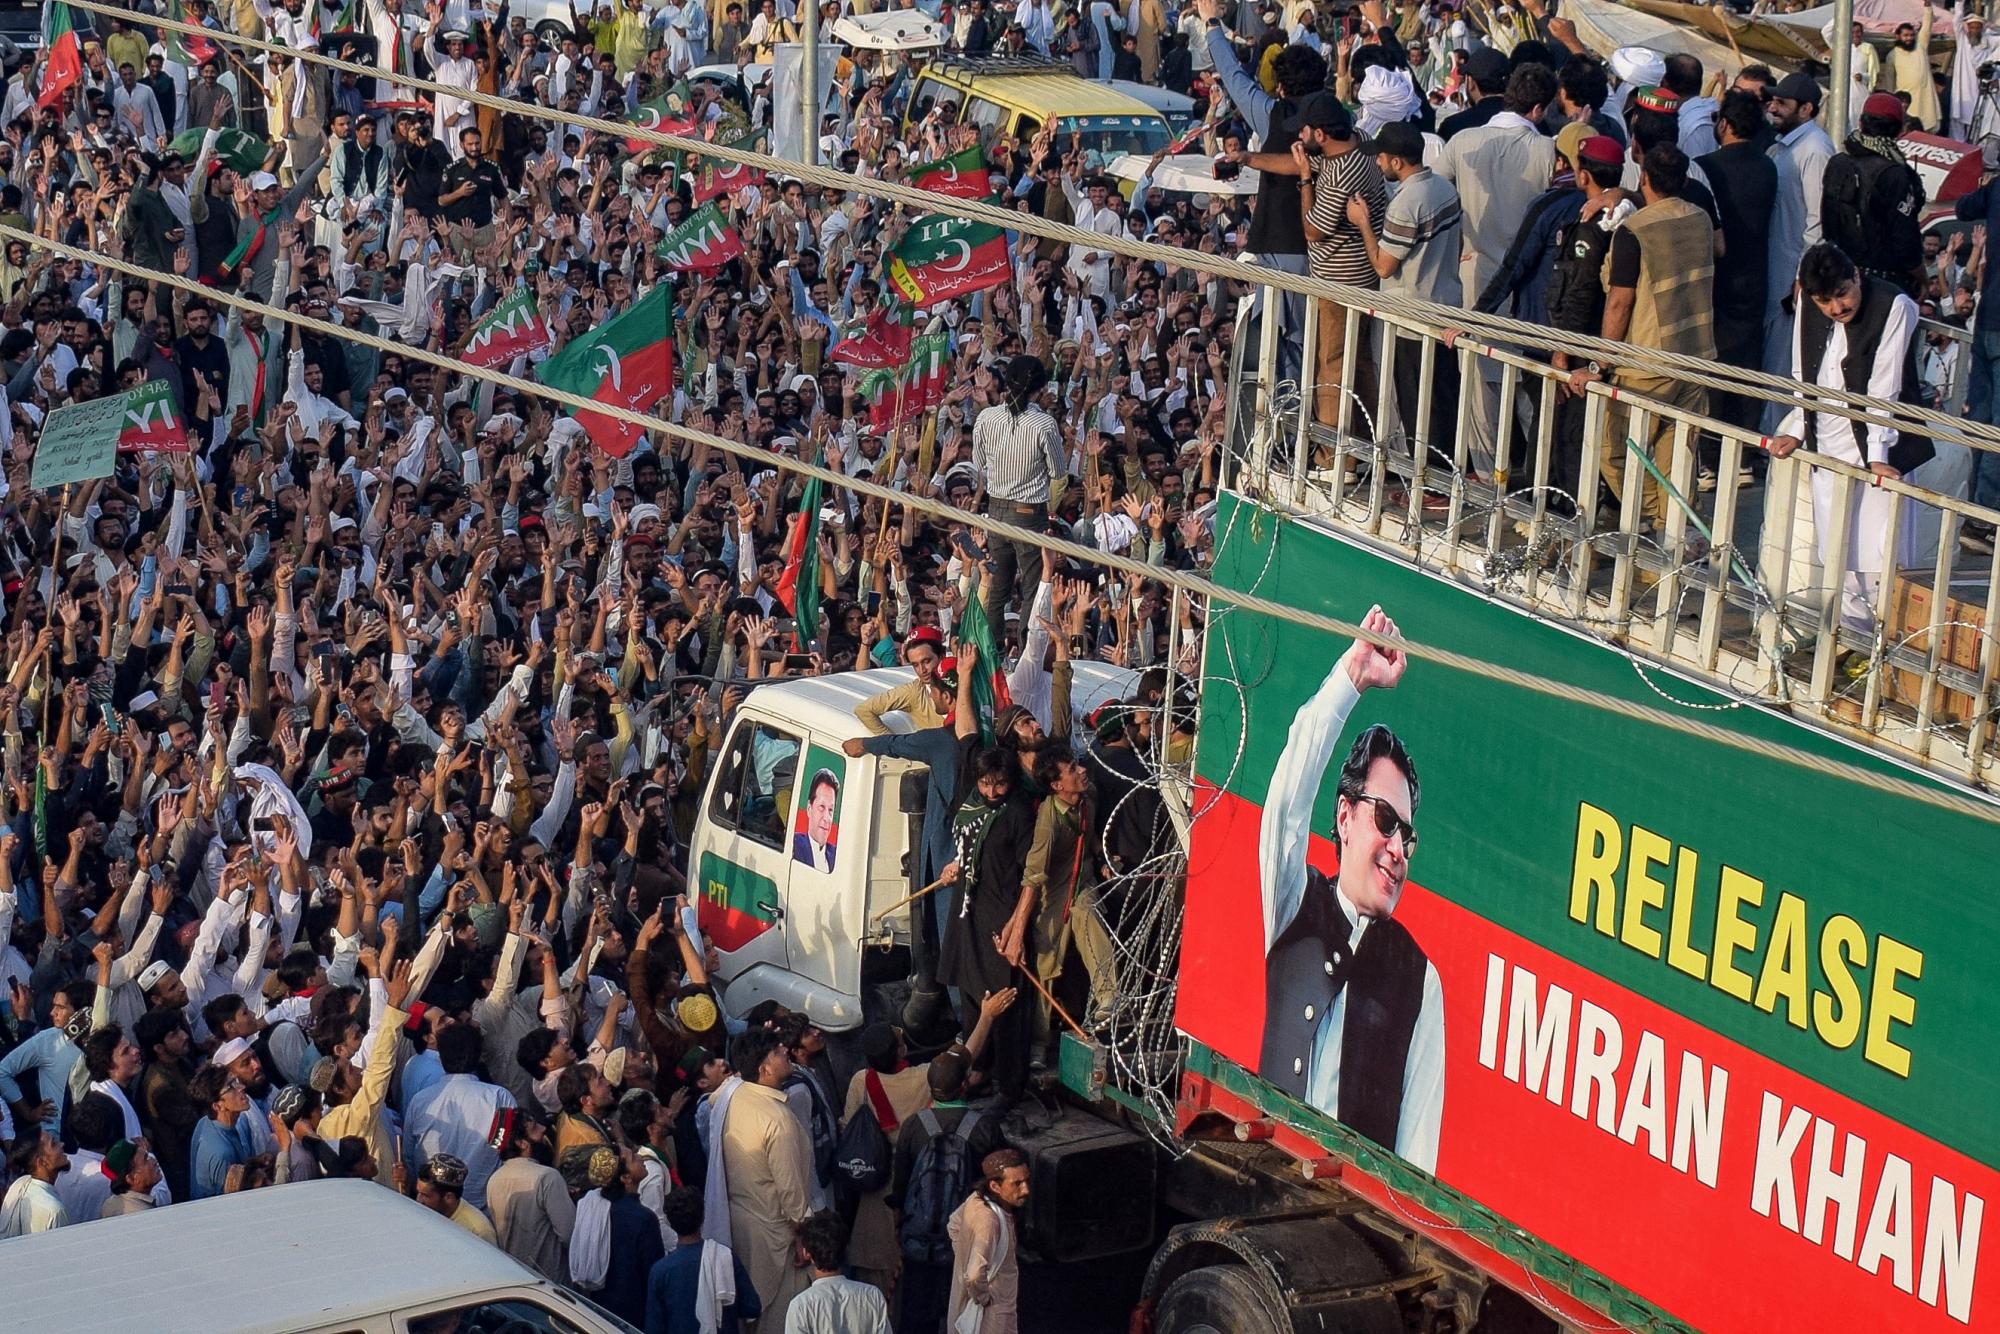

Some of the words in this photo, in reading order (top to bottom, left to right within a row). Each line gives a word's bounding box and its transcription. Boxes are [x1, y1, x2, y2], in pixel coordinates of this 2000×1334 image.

[1896, 139, 1964, 165] express
[708, 879, 728, 911] PTI
[1568, 801, 1924, 1079] RELEASE
[1478, 952, 1729, 1190] IMRAN
[1750, 1090, 1985, 1327] KHAN
